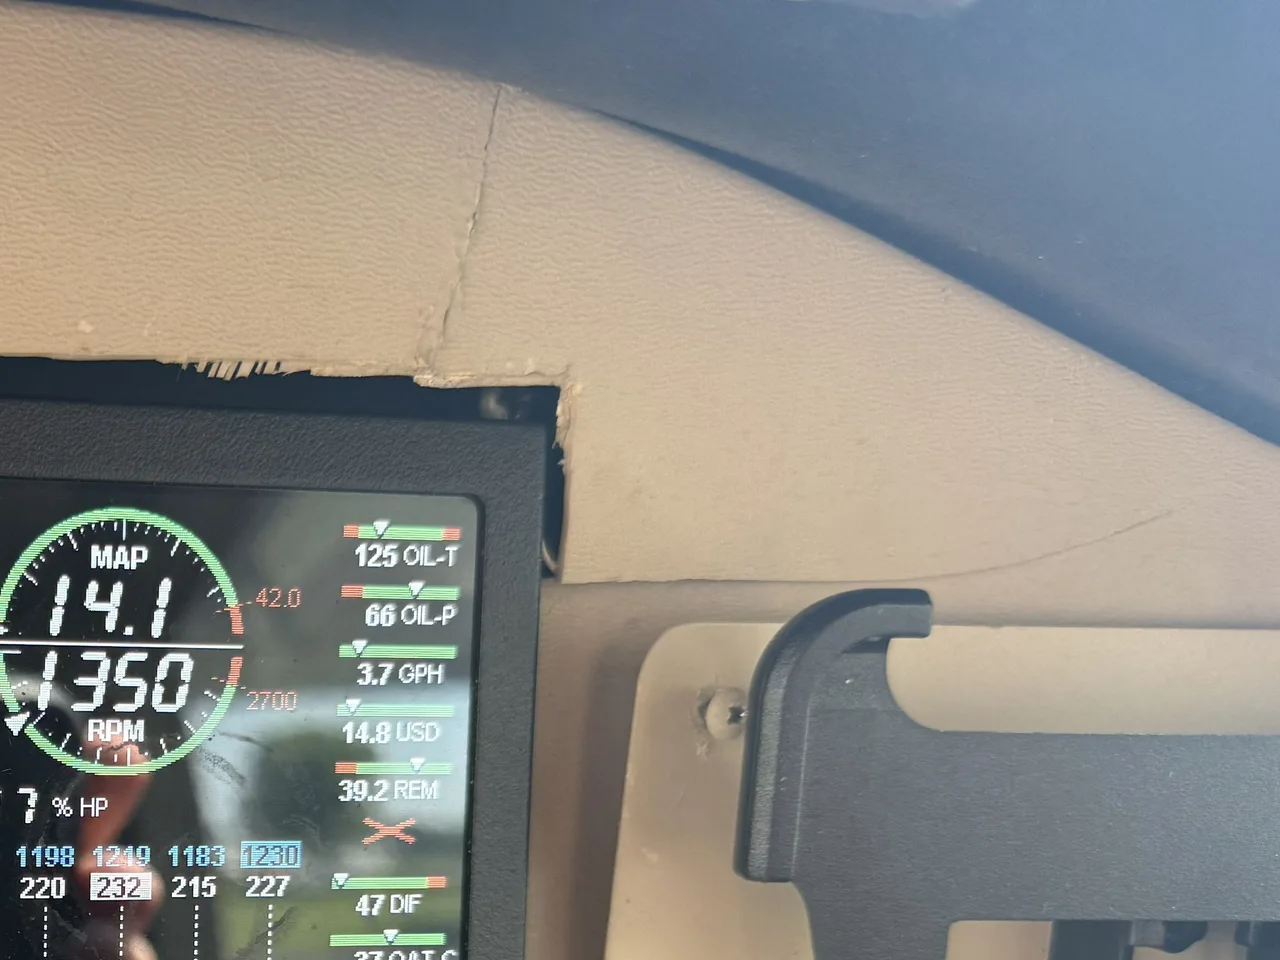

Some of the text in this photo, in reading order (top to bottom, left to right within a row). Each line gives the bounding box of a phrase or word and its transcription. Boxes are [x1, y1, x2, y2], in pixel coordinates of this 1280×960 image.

[91, 545, 148, 570] MAP
[355, 545, 460, 568] 125 OIL-T
[49, 575, 172, 638] 14.1
[255, 588, 302, 609] 42.0
[365, 604, 459, 627] 66 OIL-P
[37, 651, 195, 713] 1350
[356, 663, 446, 686] 3.7 GPH
[246, 691, 298, 712] 2700
[88, 719, 145, 743] RPM
[342, 722, 442, 744] 14.8 USD
[338, 780, 439, 802] 39.2 REM
[52, 797, 74, 818] %
[80, 798, 109, 817] HP
[16, 845, 75, 868] 1198
[92, 845, 151, 867] 1219
[168, 844, 226, 867] 1183
[242, 842, 300, 867] 1230
[20, 877, 66, 899] 220
[96, 876, 142, 898] 232
[171, 876, 217, 898] 215
[245, 875, 291, 898] 227
[355, 894, 423, 916] 47 DIF
